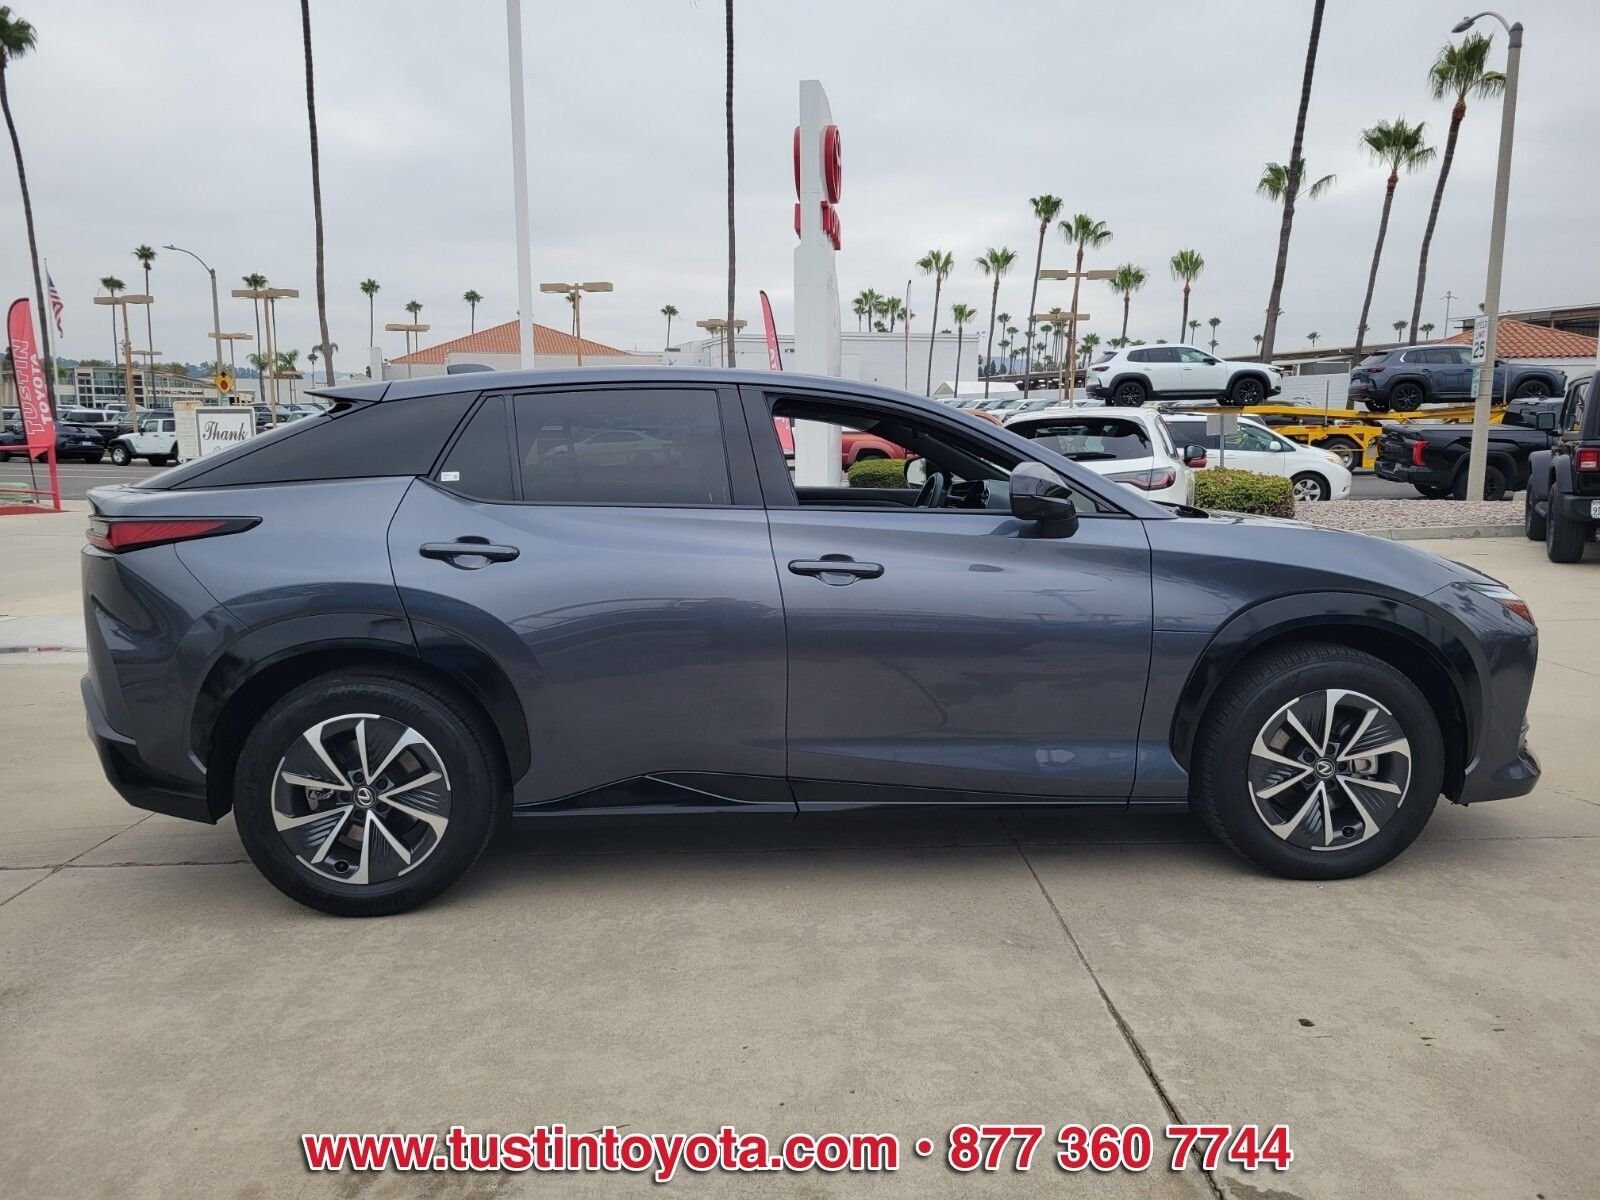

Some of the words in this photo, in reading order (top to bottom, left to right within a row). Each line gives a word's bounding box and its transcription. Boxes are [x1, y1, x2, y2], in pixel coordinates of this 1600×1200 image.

[1476, 321, 1488, 329] SPEED
[1473, 341, 1485, 358] 25
[12, 339, 45, 434] TUSTIN
[31, 353, 53, 424] TOYOTA
[203, 420, 248, 441] Thank
